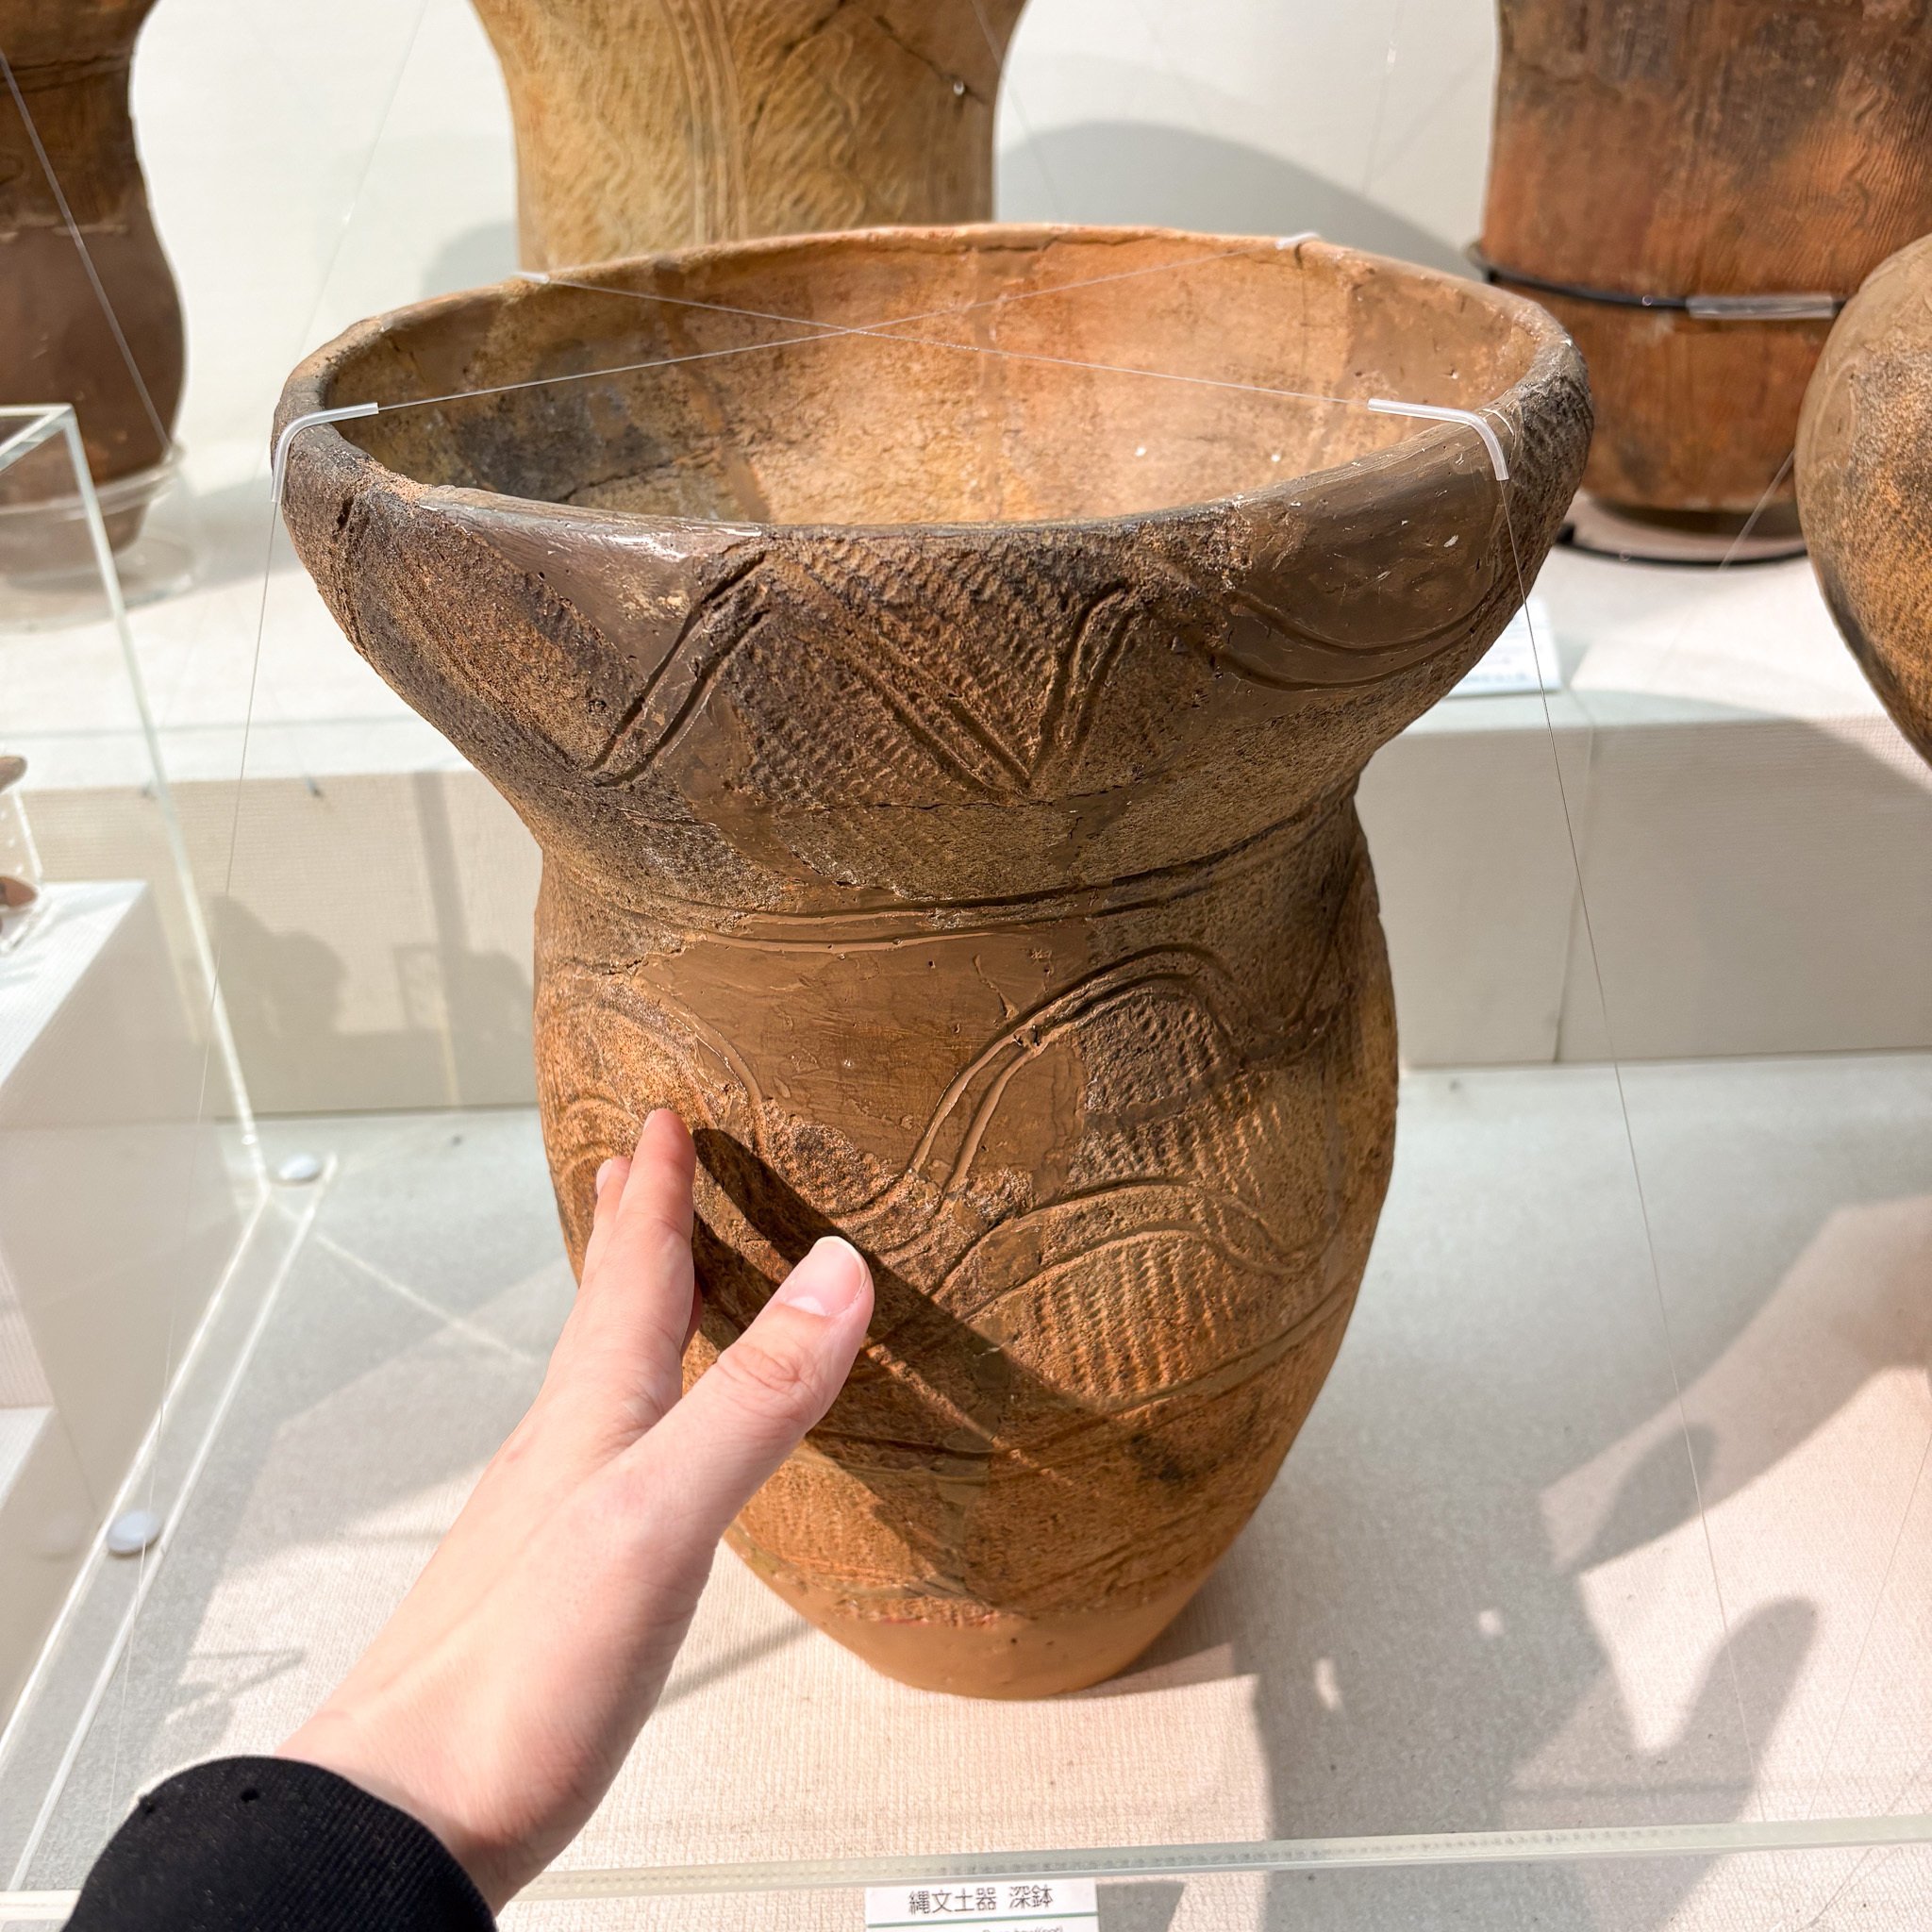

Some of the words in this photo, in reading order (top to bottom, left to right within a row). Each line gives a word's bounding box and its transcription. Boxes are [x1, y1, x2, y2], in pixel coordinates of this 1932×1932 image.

[908, 1887, 997, 1914] 縄文土器
[1009, 1884, 1053, 1908] 深鉢
